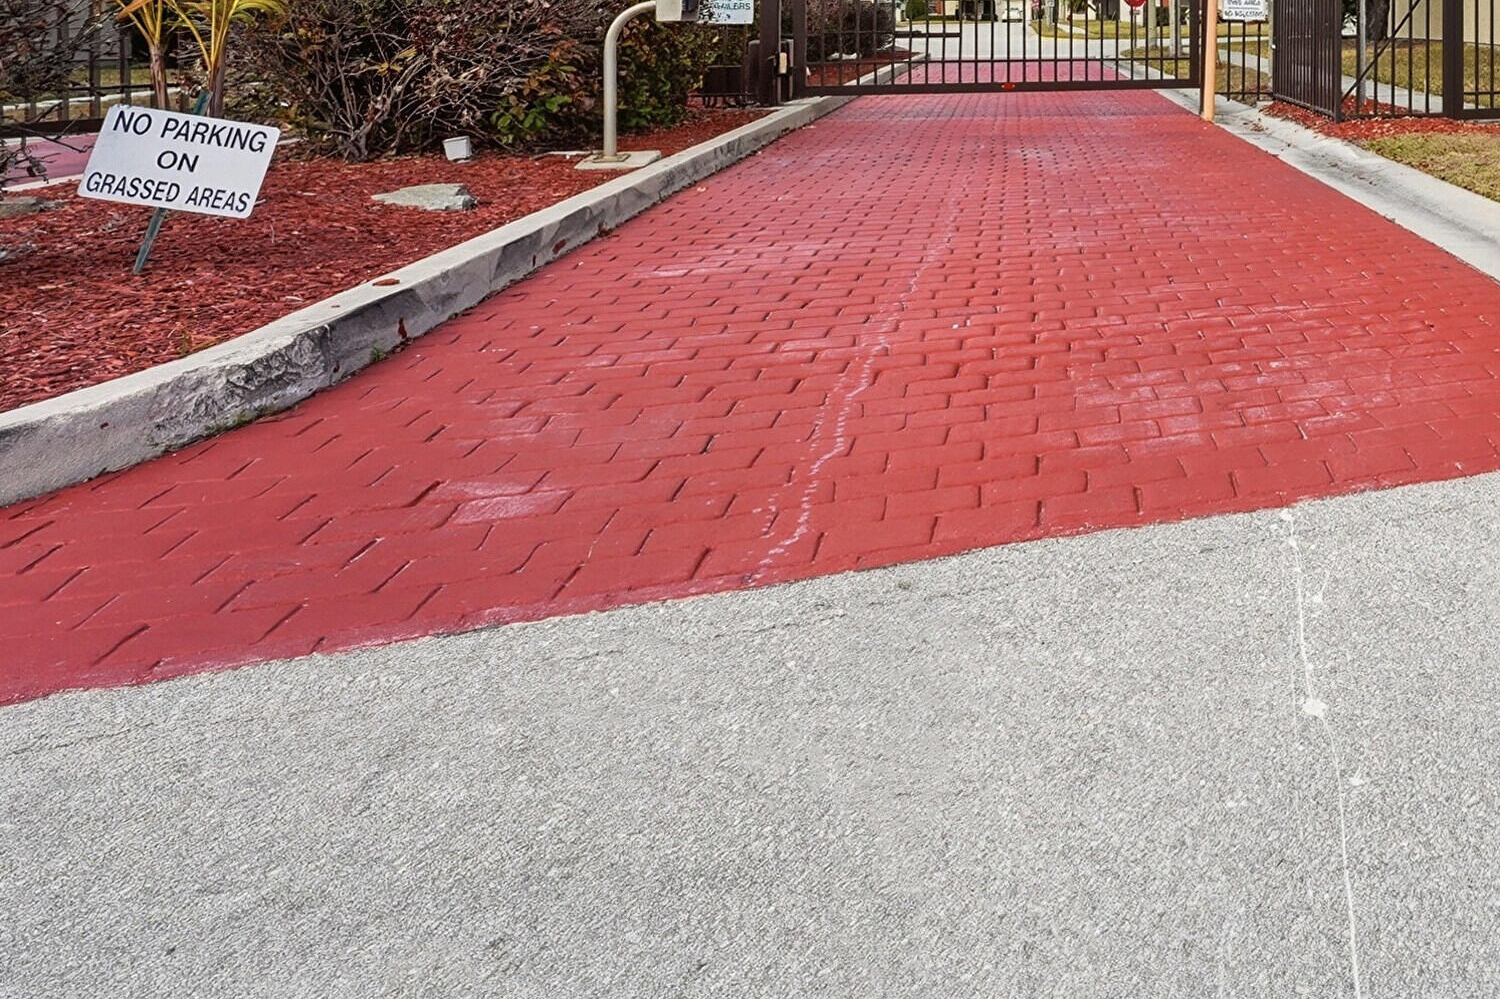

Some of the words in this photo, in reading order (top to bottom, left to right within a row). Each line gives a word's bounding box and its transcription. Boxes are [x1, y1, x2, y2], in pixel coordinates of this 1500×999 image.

[711, 2, 751, 11] RAILERS
[112, 110, 152, 135] NO
[160, 117, 267, 152] PARKING
[157, 150, 199, 172] ON
[86, 172, 180, 202] GRASSED
[185, 186, 250, 212] AREAS
